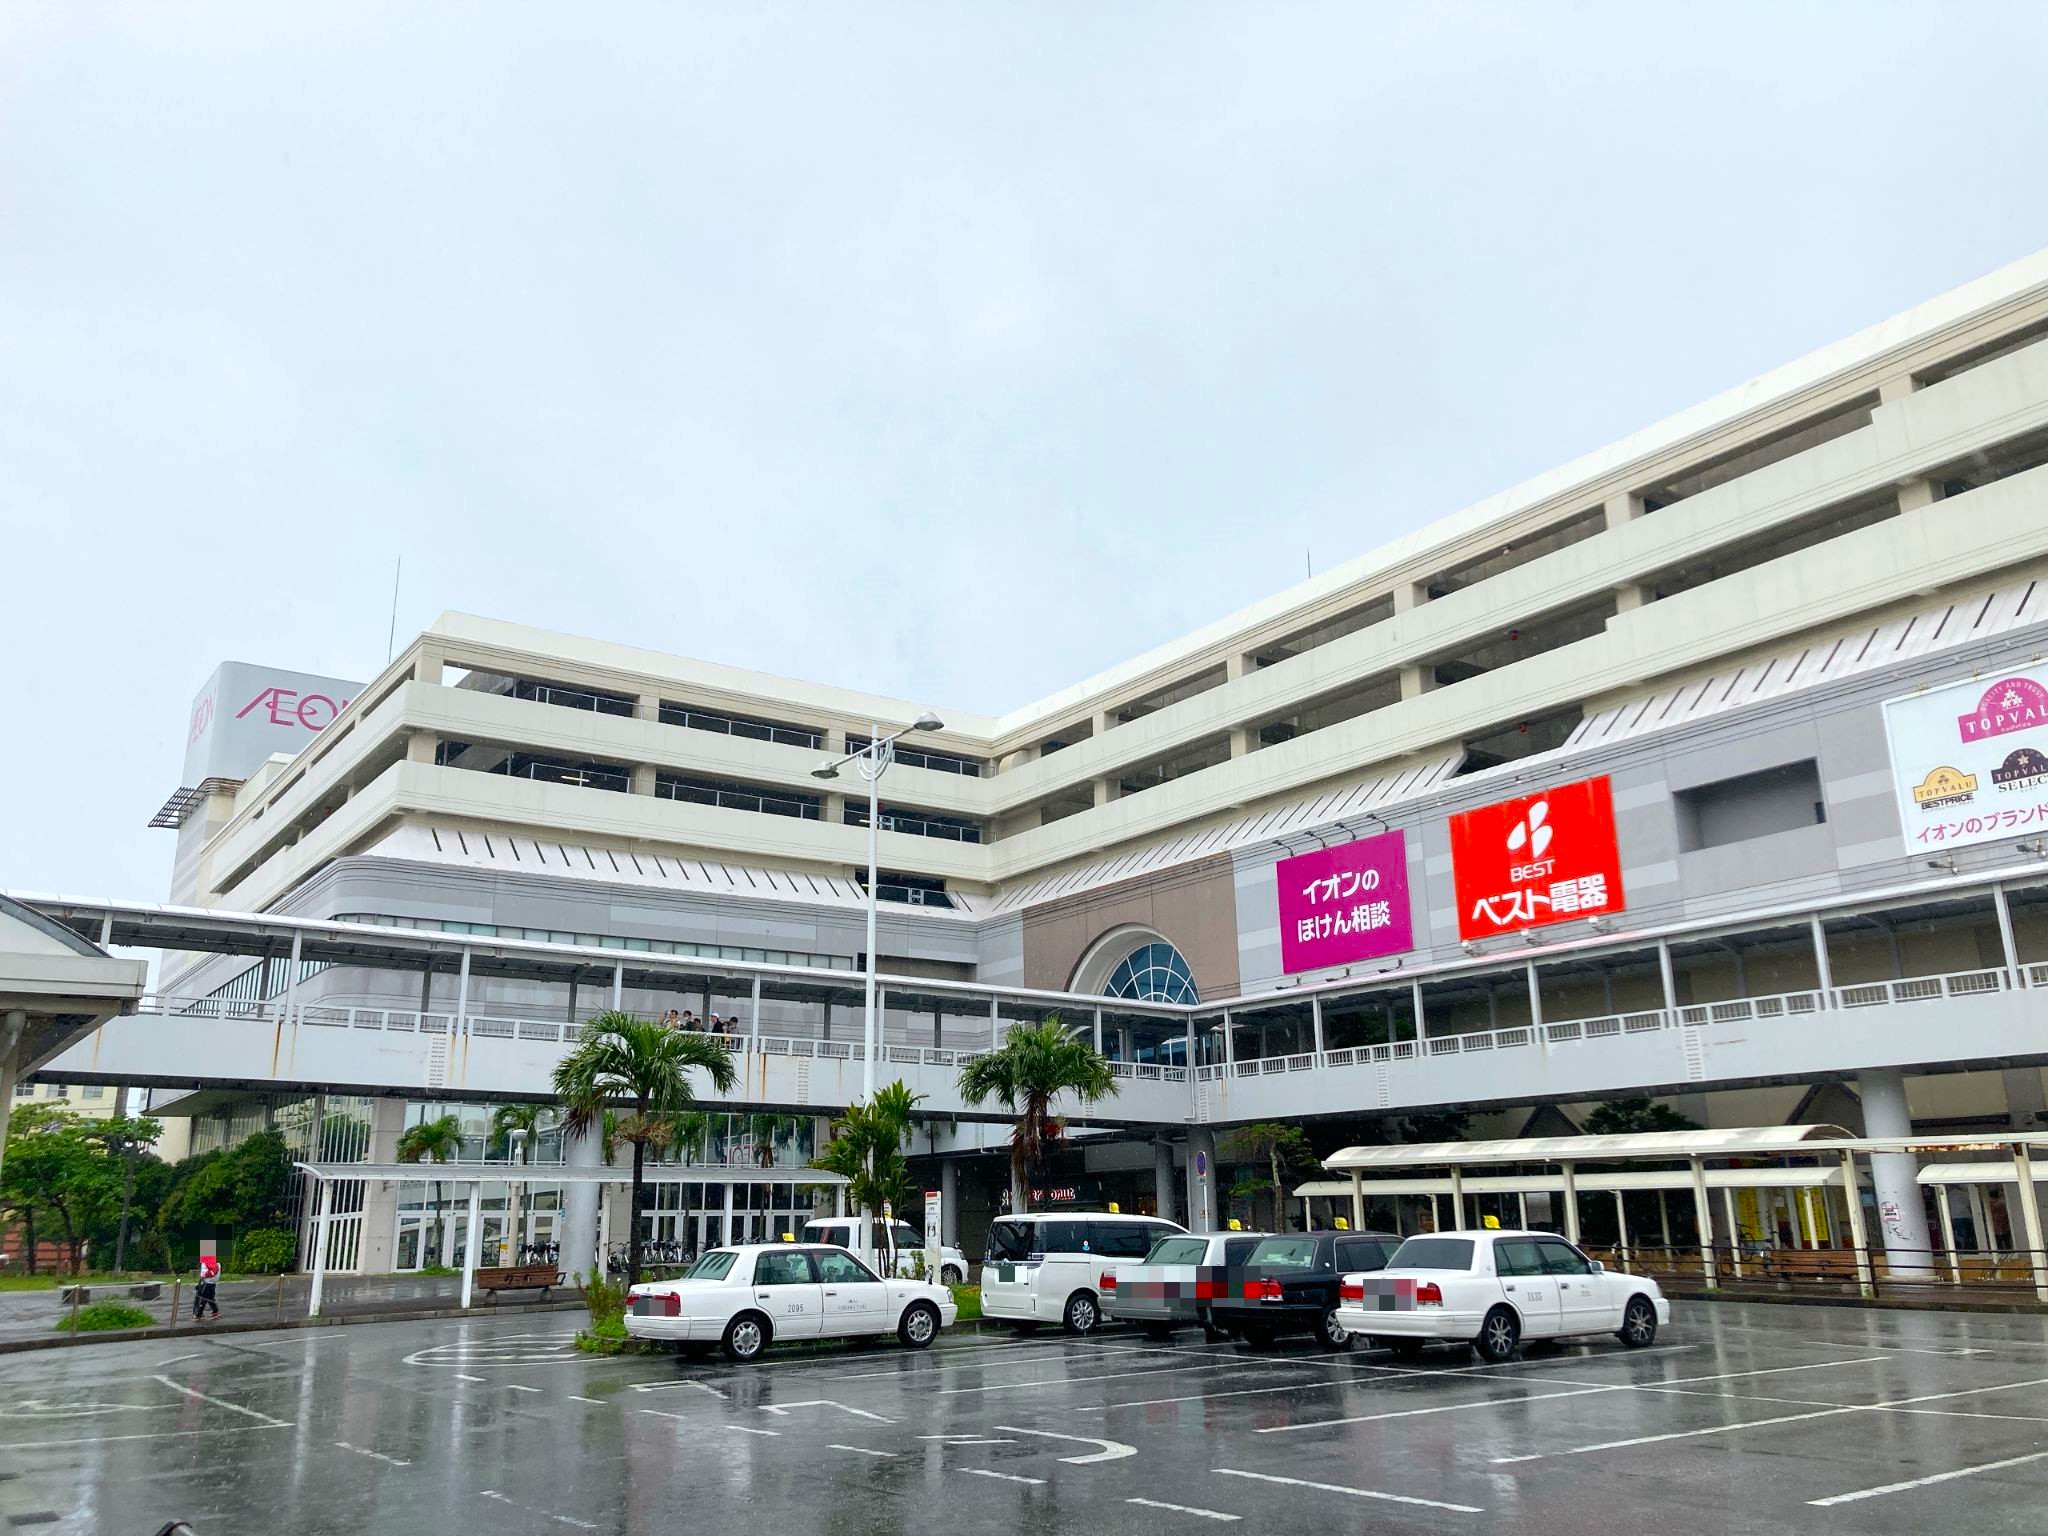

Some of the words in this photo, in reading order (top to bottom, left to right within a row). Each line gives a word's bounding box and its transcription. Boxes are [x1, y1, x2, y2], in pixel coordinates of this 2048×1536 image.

[1918, 781, 1972, 798] TOPVALU
[1998, 774, 2048, 793] SELEC
[1510, 859, 1555, 882] BEST
[1302, 869, 1379, 905] イオンの
[1471, 873, 1609, 925] ベスト電器
[1297, 900, 1391, 943] ほけん相談
[787, 1303, 804, 1313] 2095
